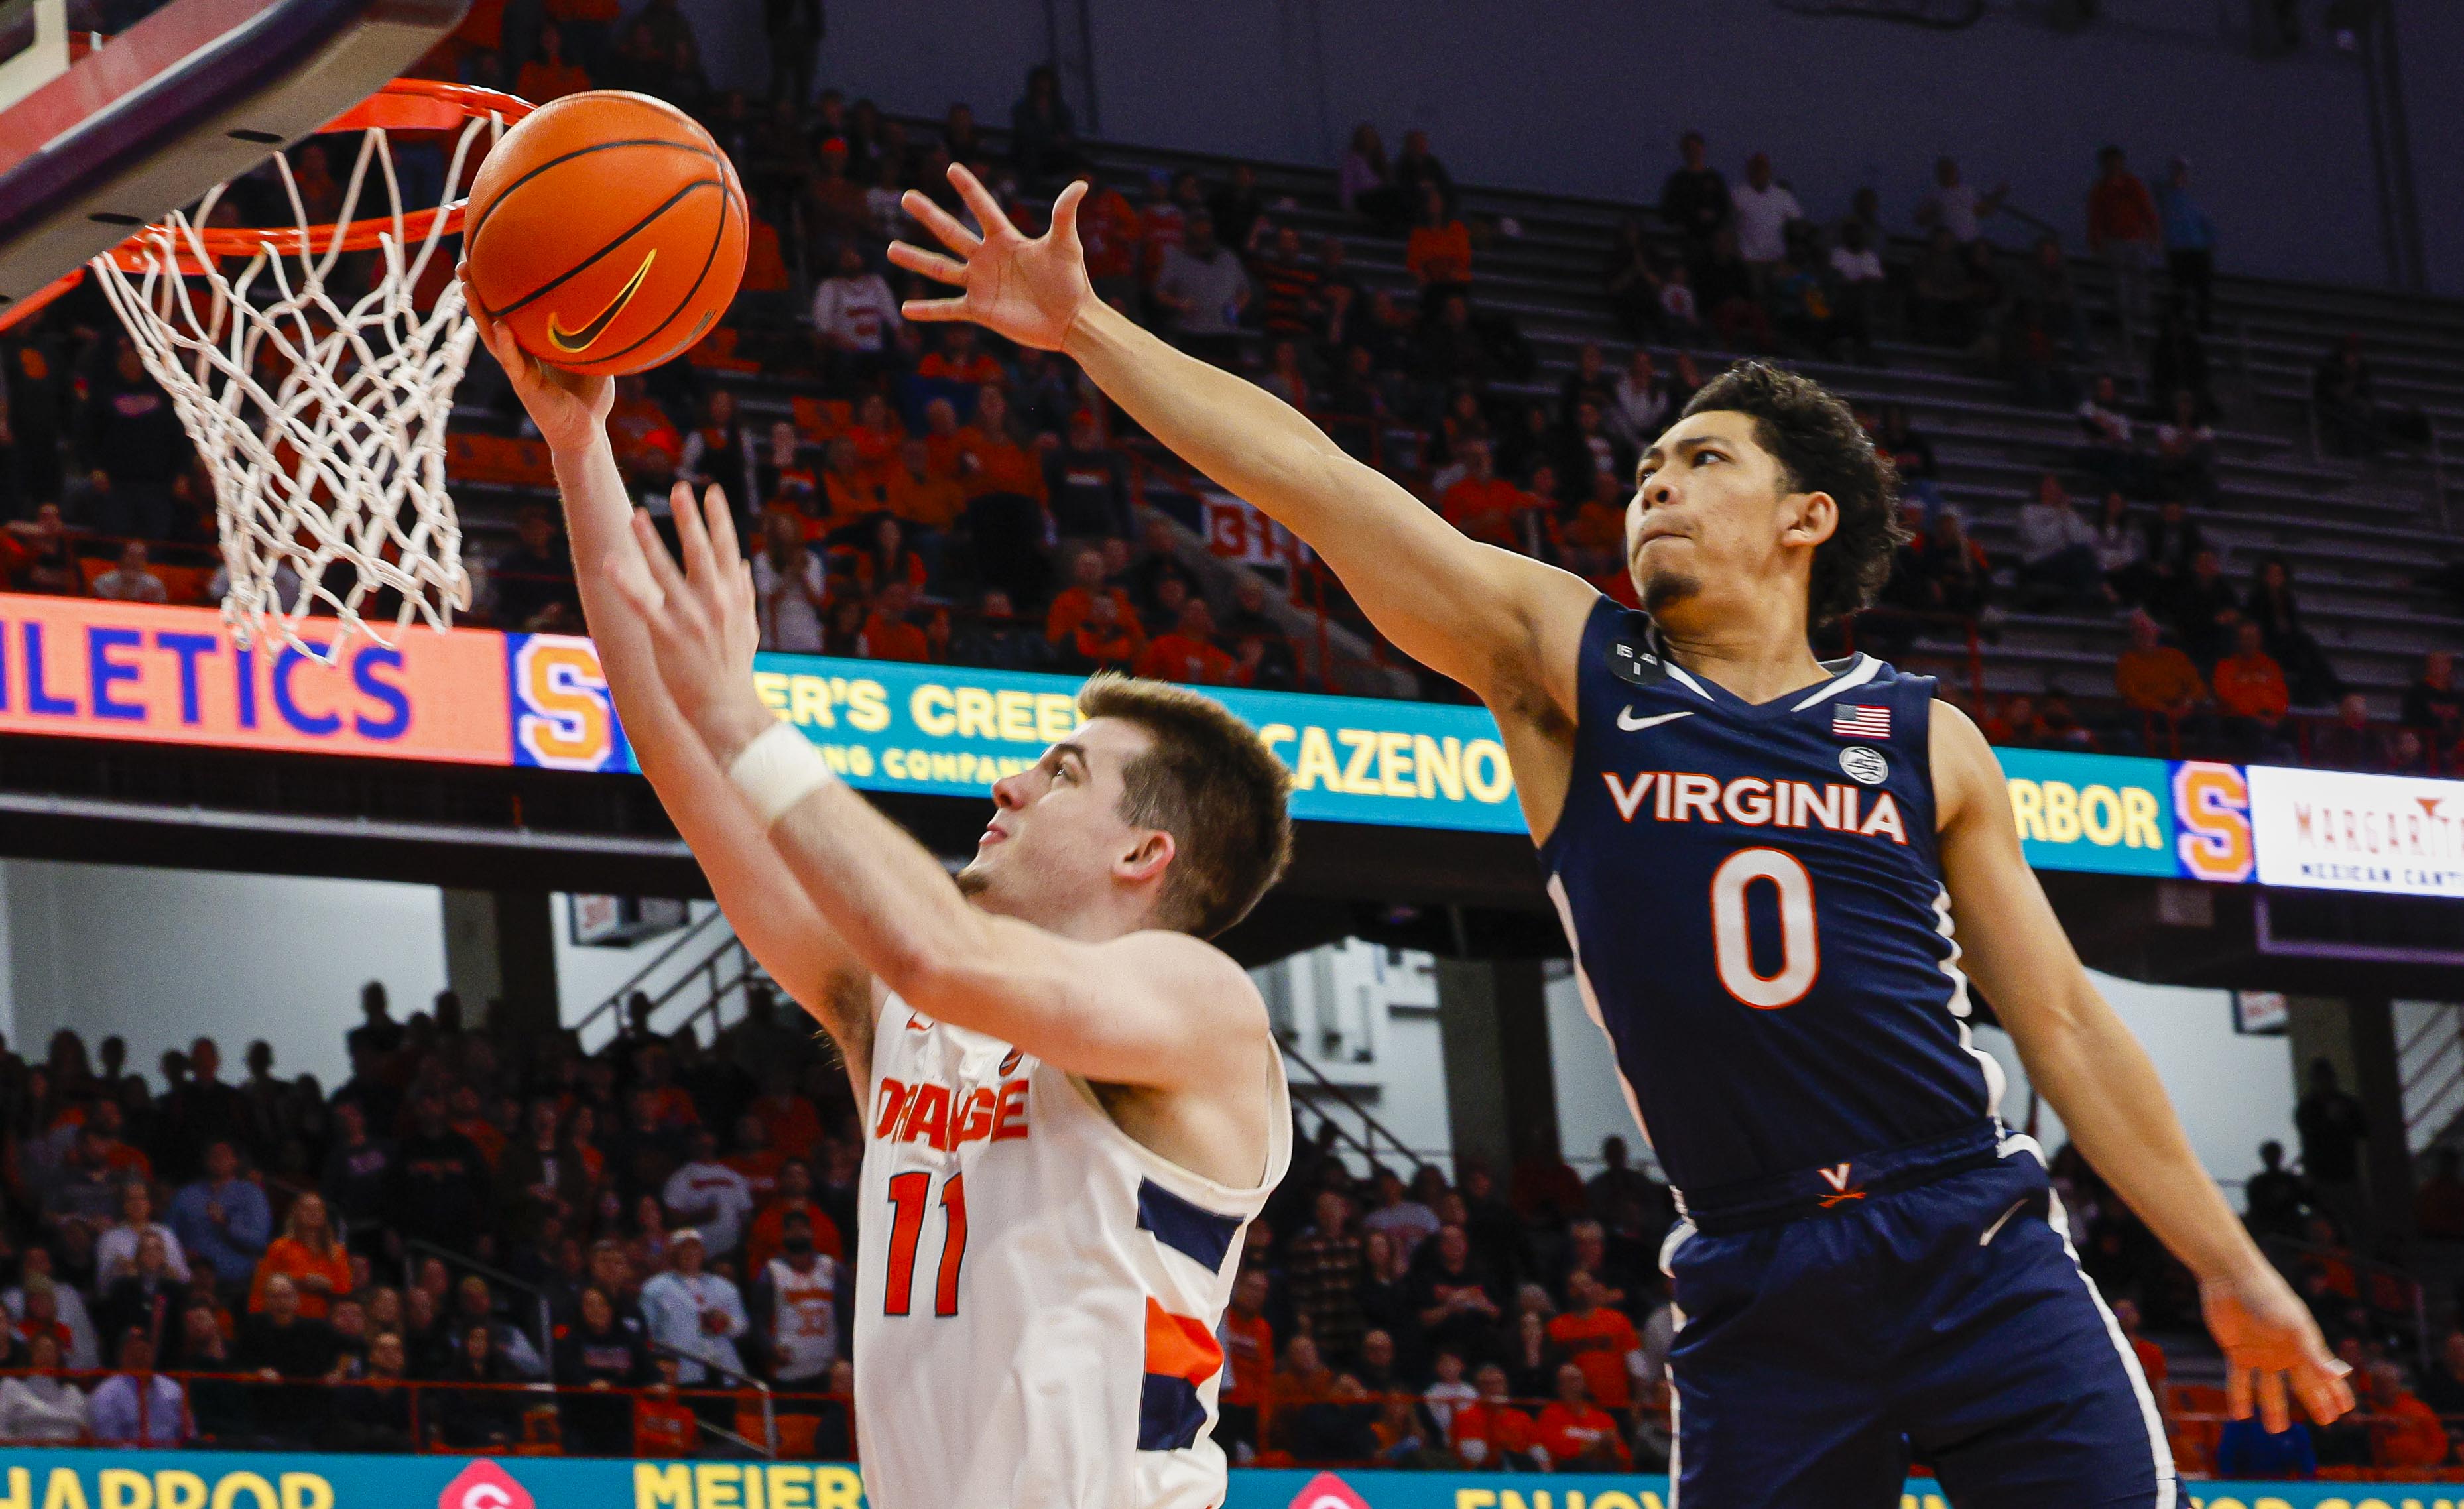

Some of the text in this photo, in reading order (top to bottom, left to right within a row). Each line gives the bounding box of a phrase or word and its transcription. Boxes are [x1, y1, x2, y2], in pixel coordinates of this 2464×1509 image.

[0, 619, 411, 740] LETICS
[911, 684, 1086, 743] CREE
[882, 747, 1038, 784] COMPAN
[1601, 770, 1910, 846] VIRGINIA
[2173, 760, 2256, 882] S
[2293, 800, 2464, 859] MARGARIT
[1709, 845, 1821, 1010] 0
[883, 1170, 968, 1317] 11
